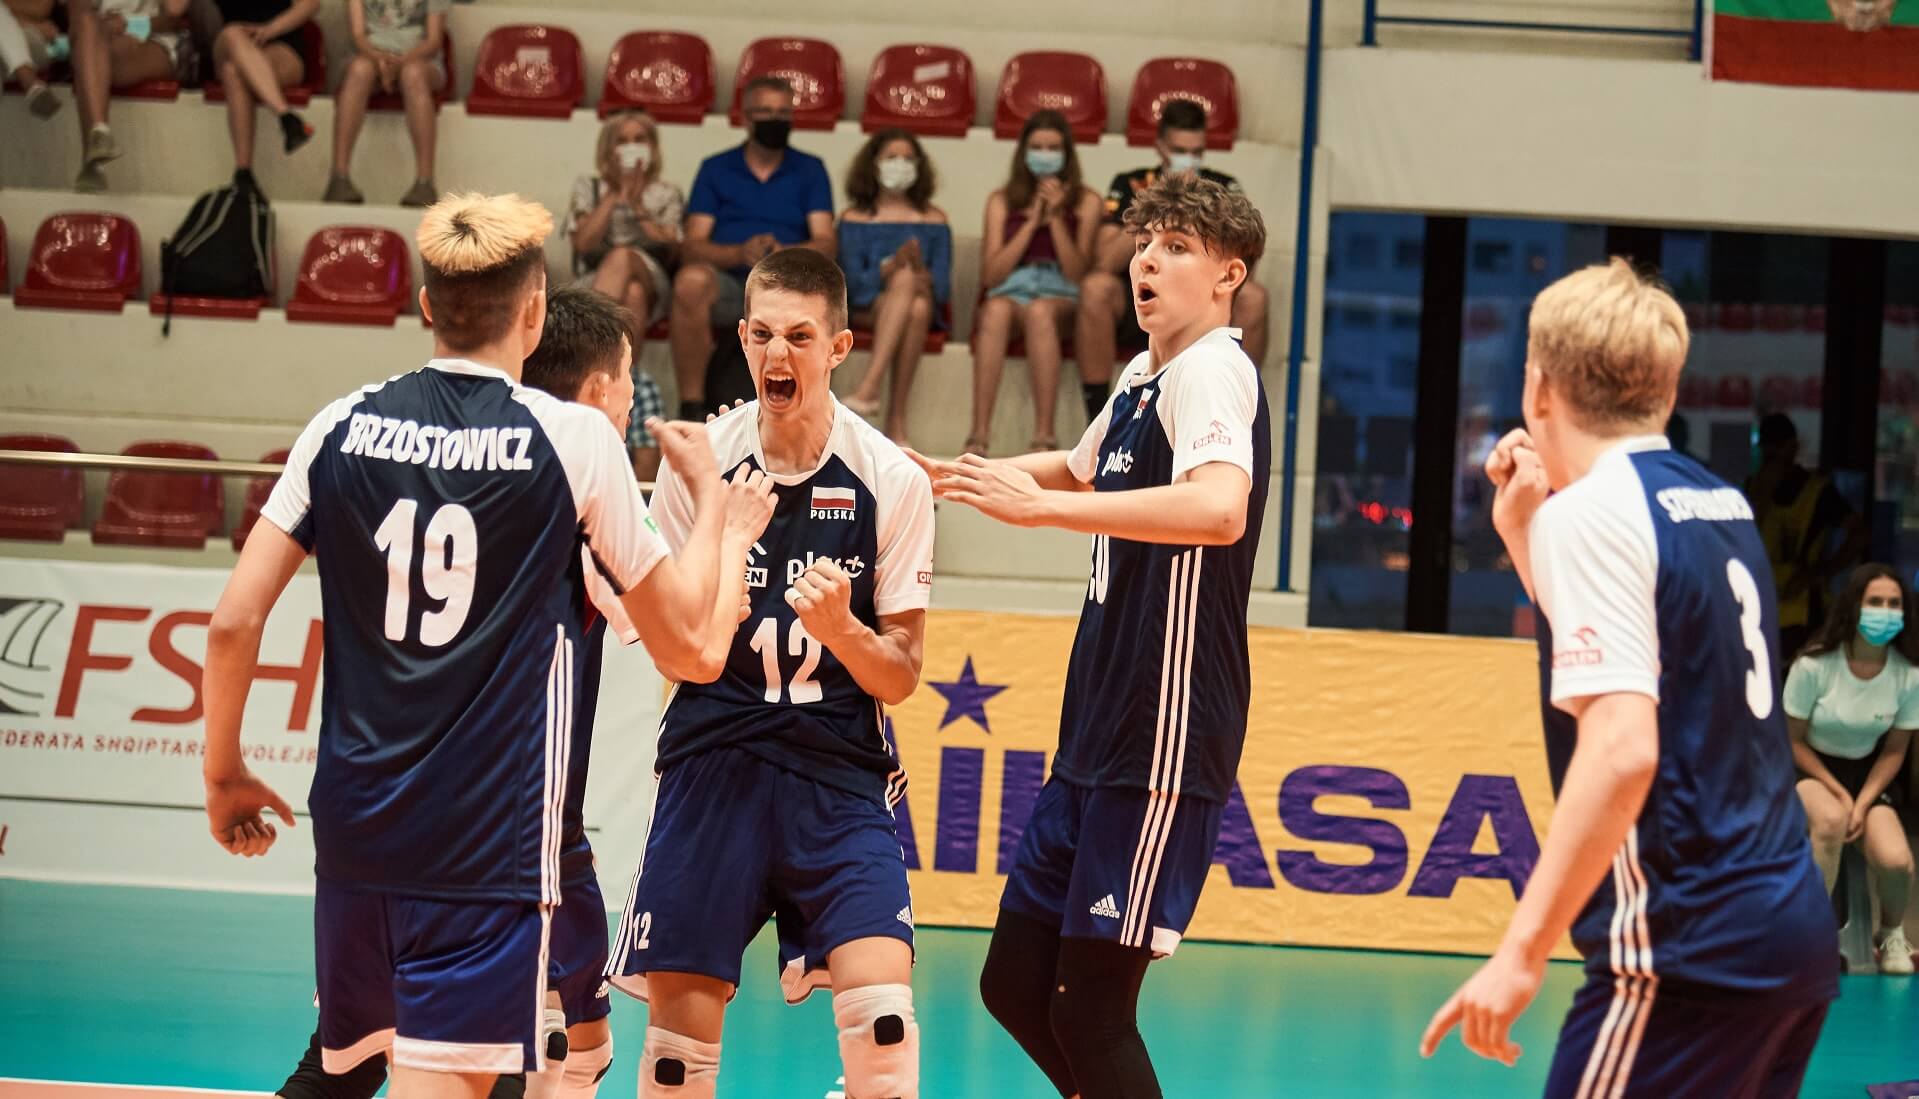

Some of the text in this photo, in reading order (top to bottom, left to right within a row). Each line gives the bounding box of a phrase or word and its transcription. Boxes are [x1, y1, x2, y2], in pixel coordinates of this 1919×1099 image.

[339, 411, 533, 471] BRZOSTOWICZ
[810, 509, 855, 521] POLSKA
[373, 498, 478, 647] 19
[750, 617, 823, 705] 12
[1726, 557, 1773, 720] 3
[0, 729, 84, 750] DERATA
[632, 911, 652, 951] 12
[1090, 905, 1120, 919] adidas
